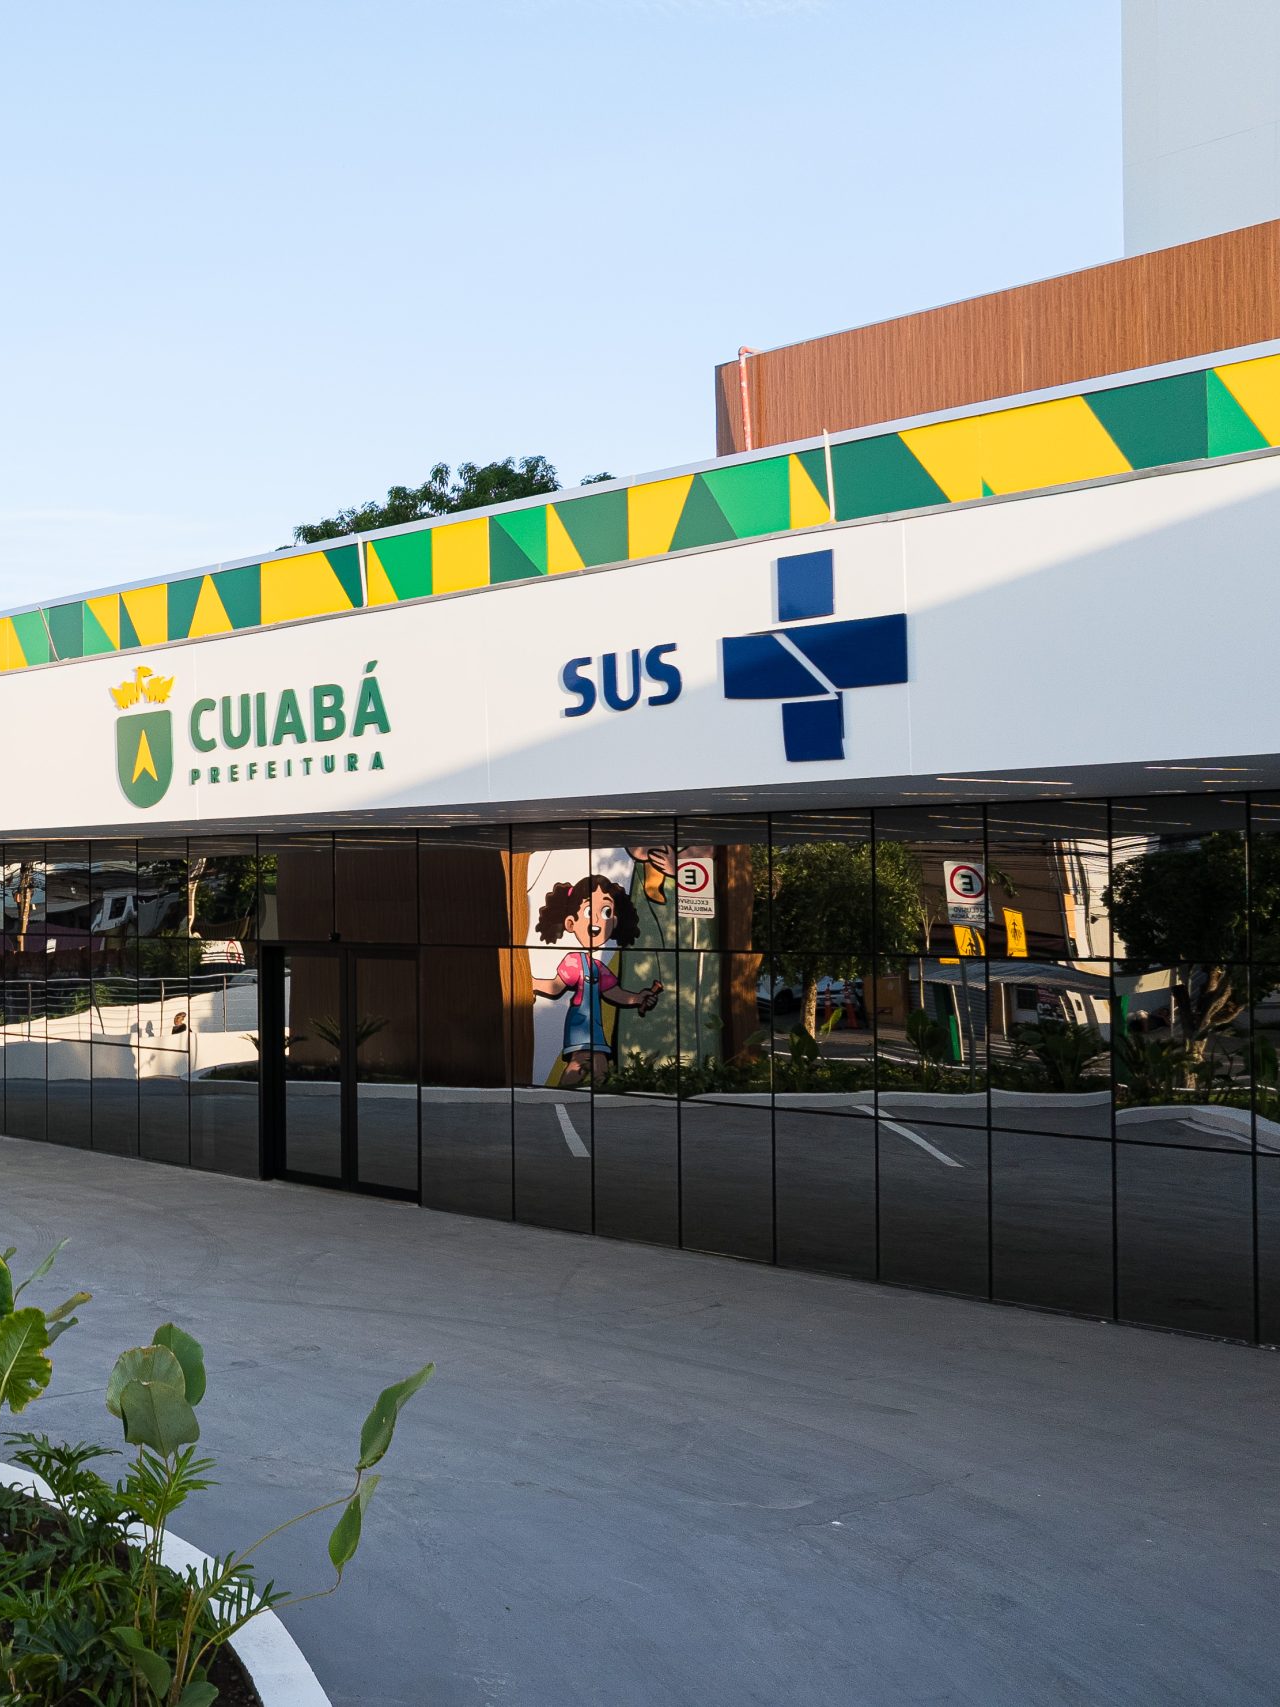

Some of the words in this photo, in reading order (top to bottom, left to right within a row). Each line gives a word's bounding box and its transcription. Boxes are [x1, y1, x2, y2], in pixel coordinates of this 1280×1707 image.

[189, 659, 392, 753] CUIABÁ
[559, 642, 683, 718] SUS
[189, 751, 385, 786] PREFEITURA
